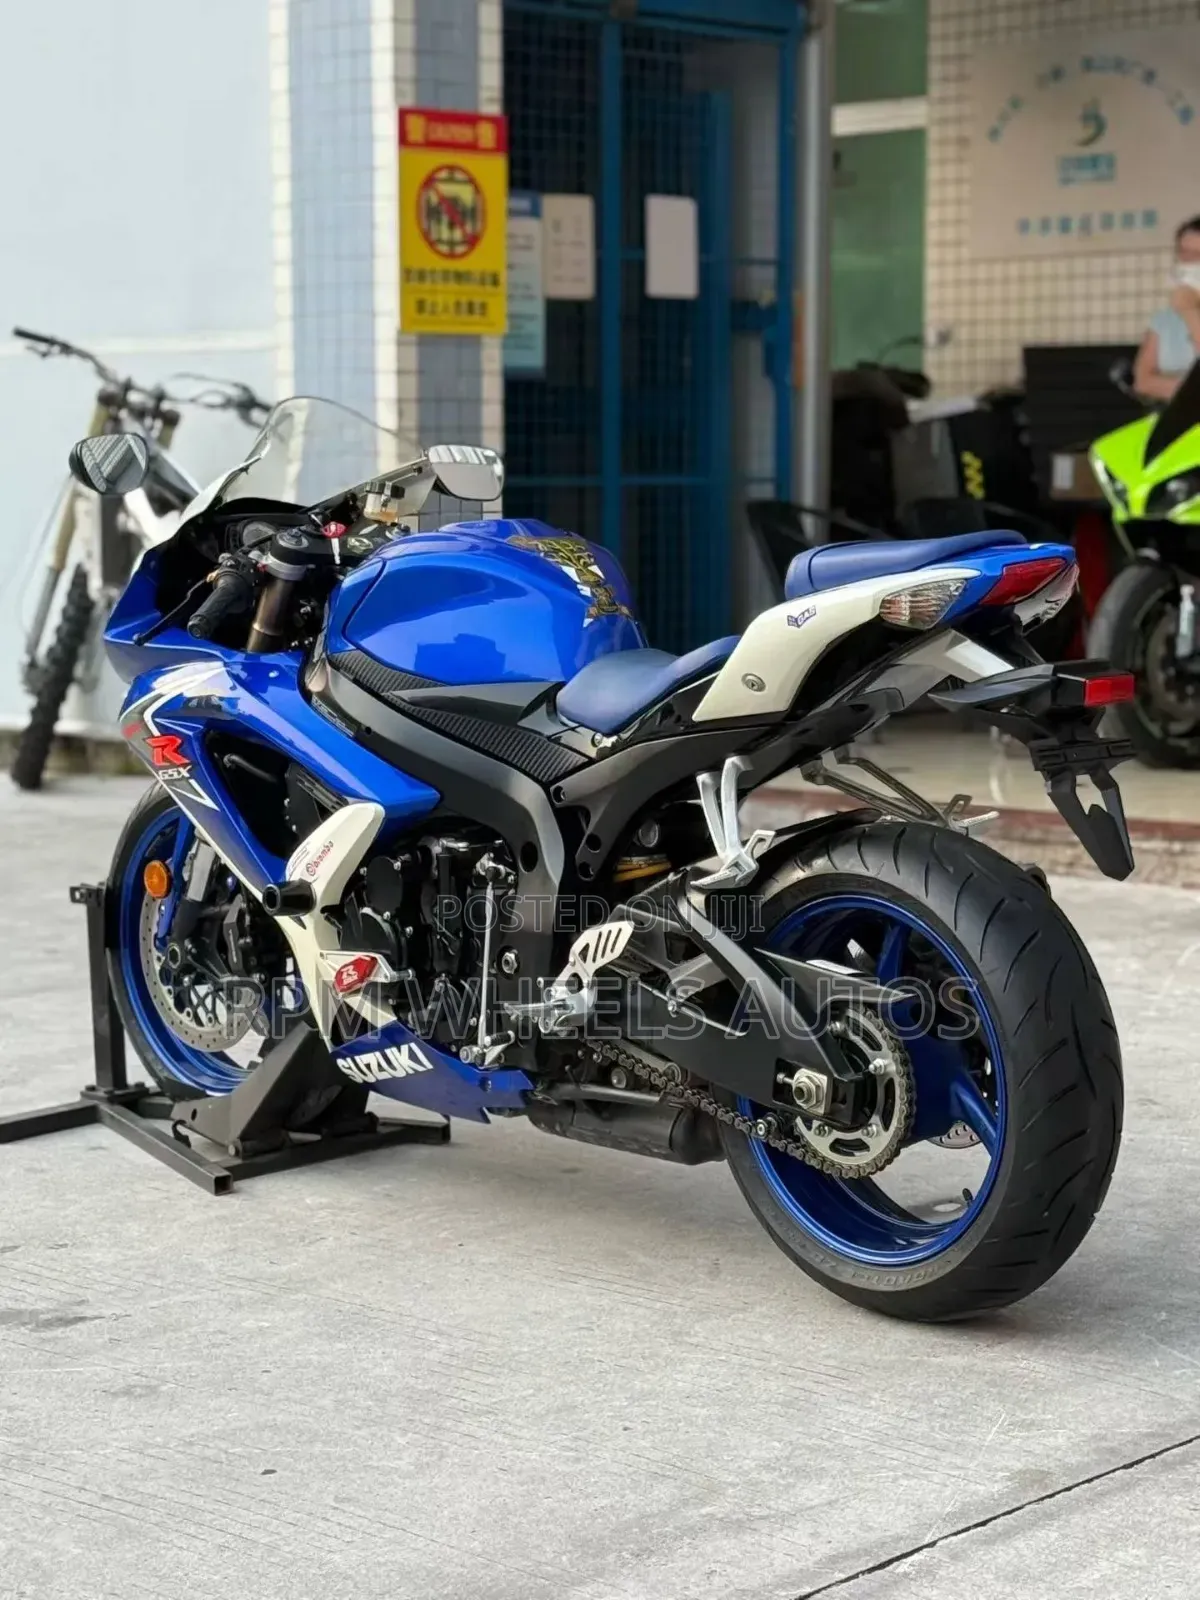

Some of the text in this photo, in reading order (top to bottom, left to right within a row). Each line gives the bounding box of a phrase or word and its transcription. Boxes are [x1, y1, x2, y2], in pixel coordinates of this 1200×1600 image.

[145, 735, 190, 766] R
[158, 765, 192, 780] GSX
[336, 1042, 434, 1084] SUZUKI
